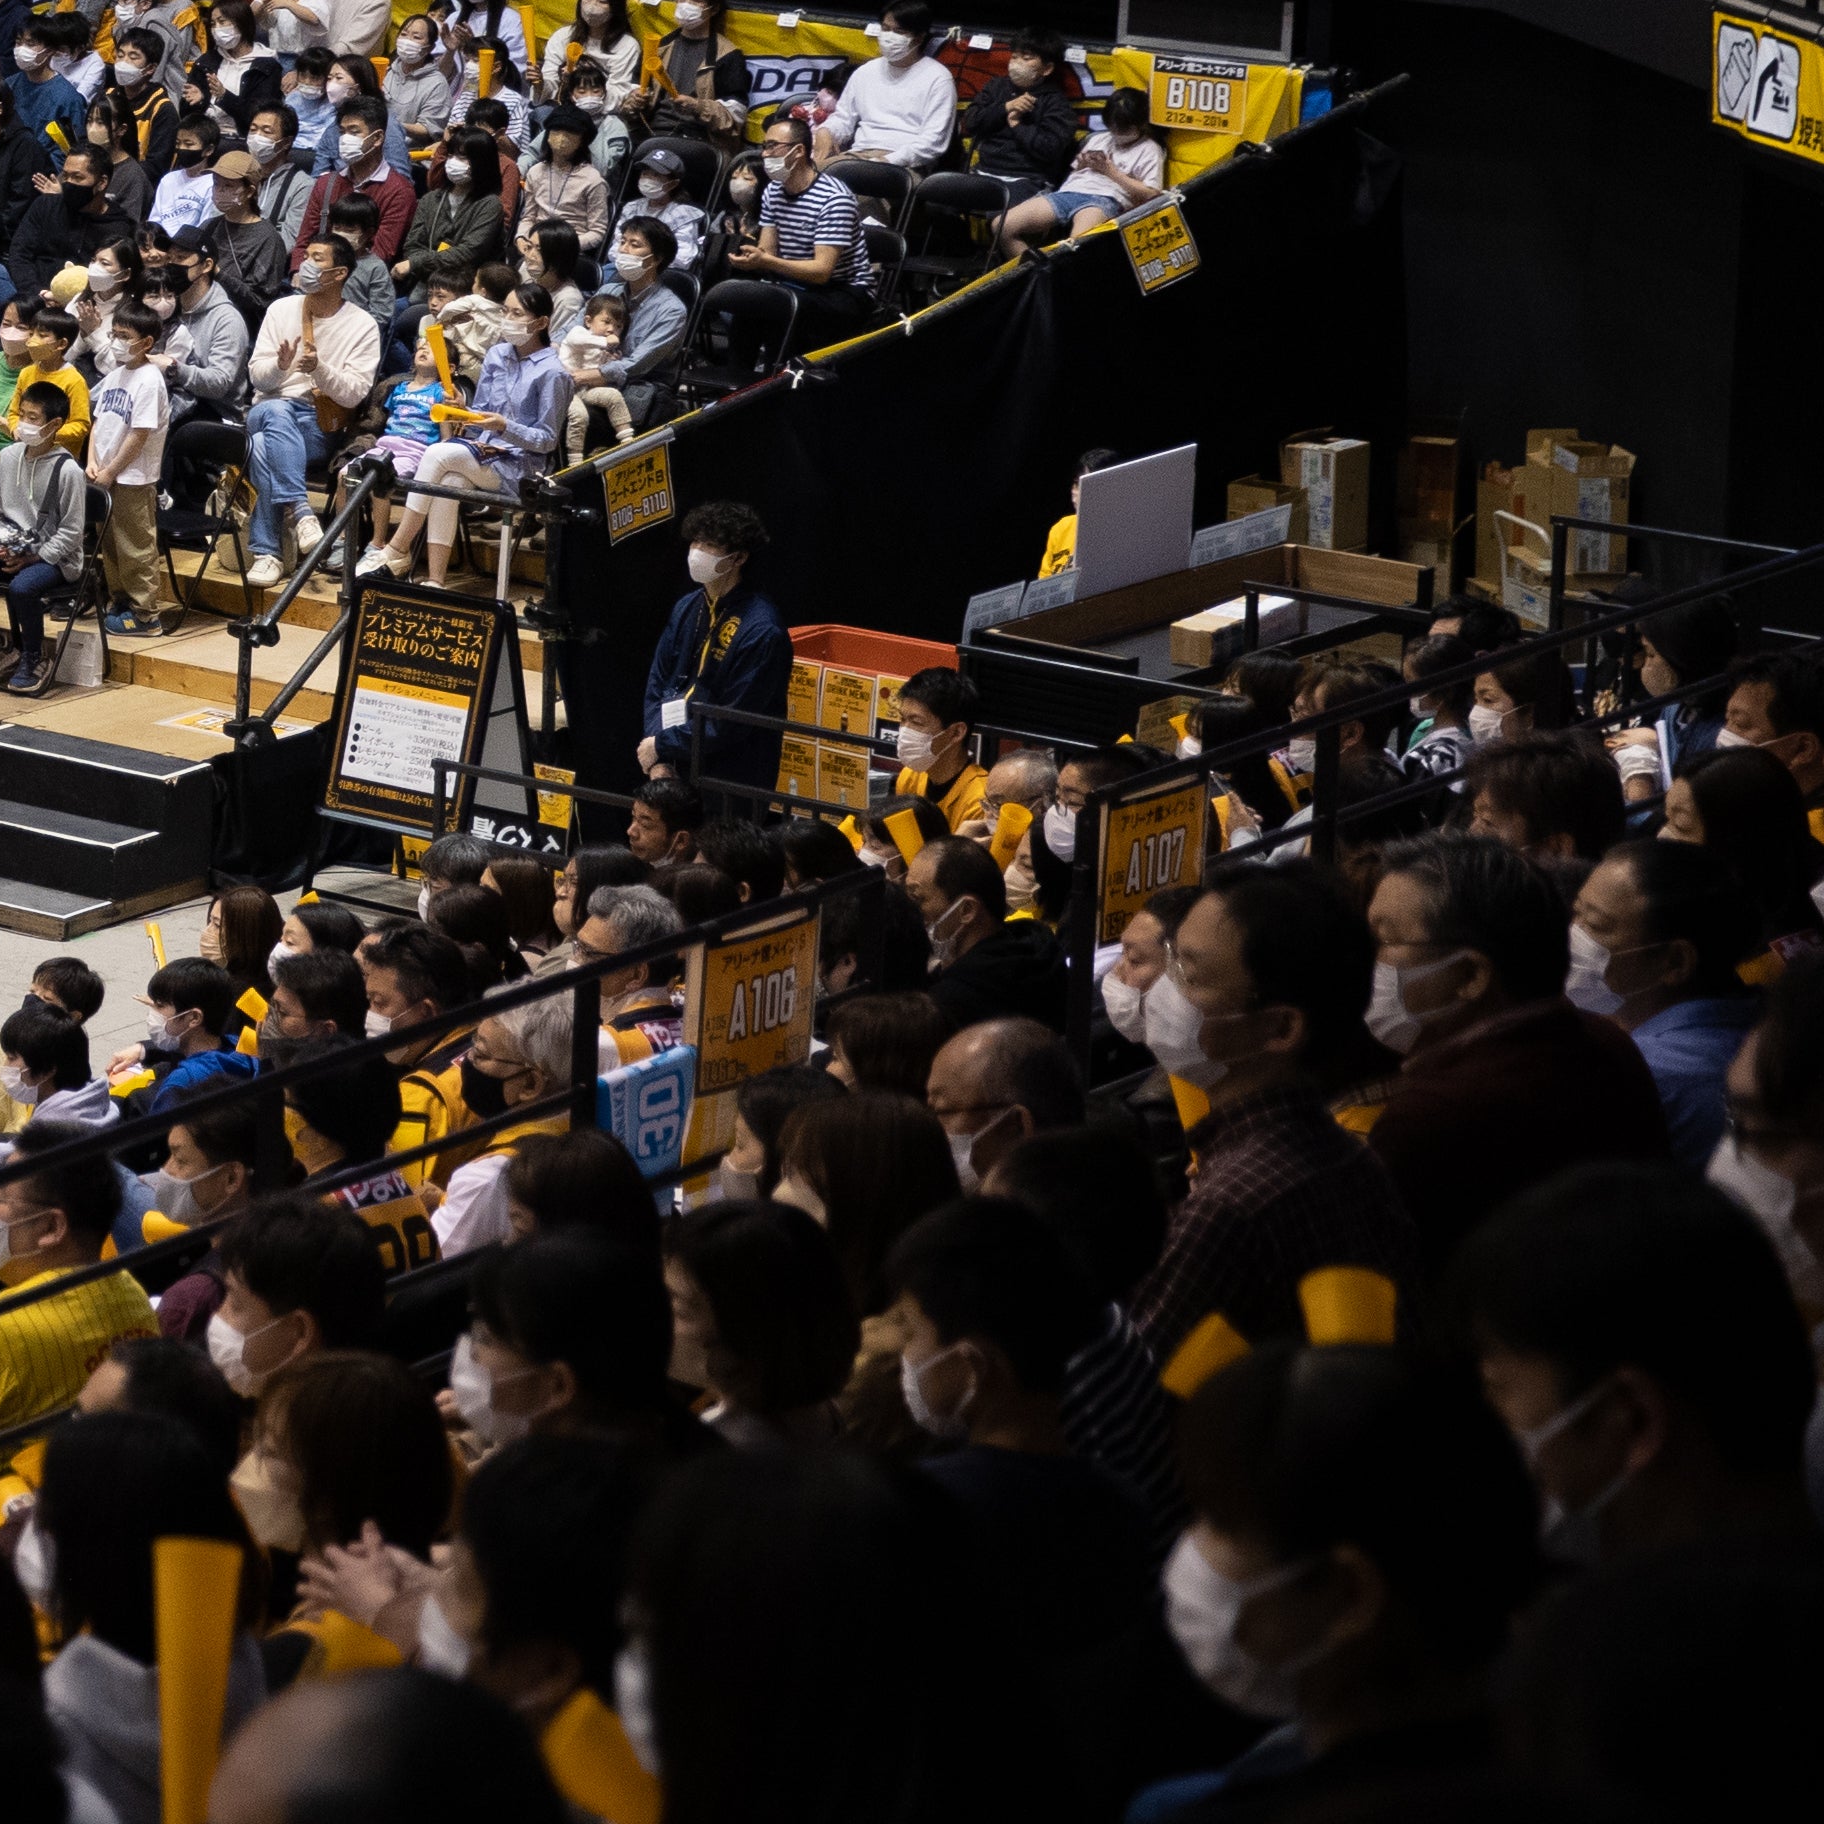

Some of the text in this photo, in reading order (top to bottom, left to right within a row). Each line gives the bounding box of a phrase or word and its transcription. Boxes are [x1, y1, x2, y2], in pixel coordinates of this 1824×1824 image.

[1167, 77, 1232, 114] B108
[365, 612, 484, 650] プレミアムサービス
[362, 632, 481, 670] 受け取りのご案内
[1125, 825, 1188, 895] A107
[728, 964, 798, 1045] A106
